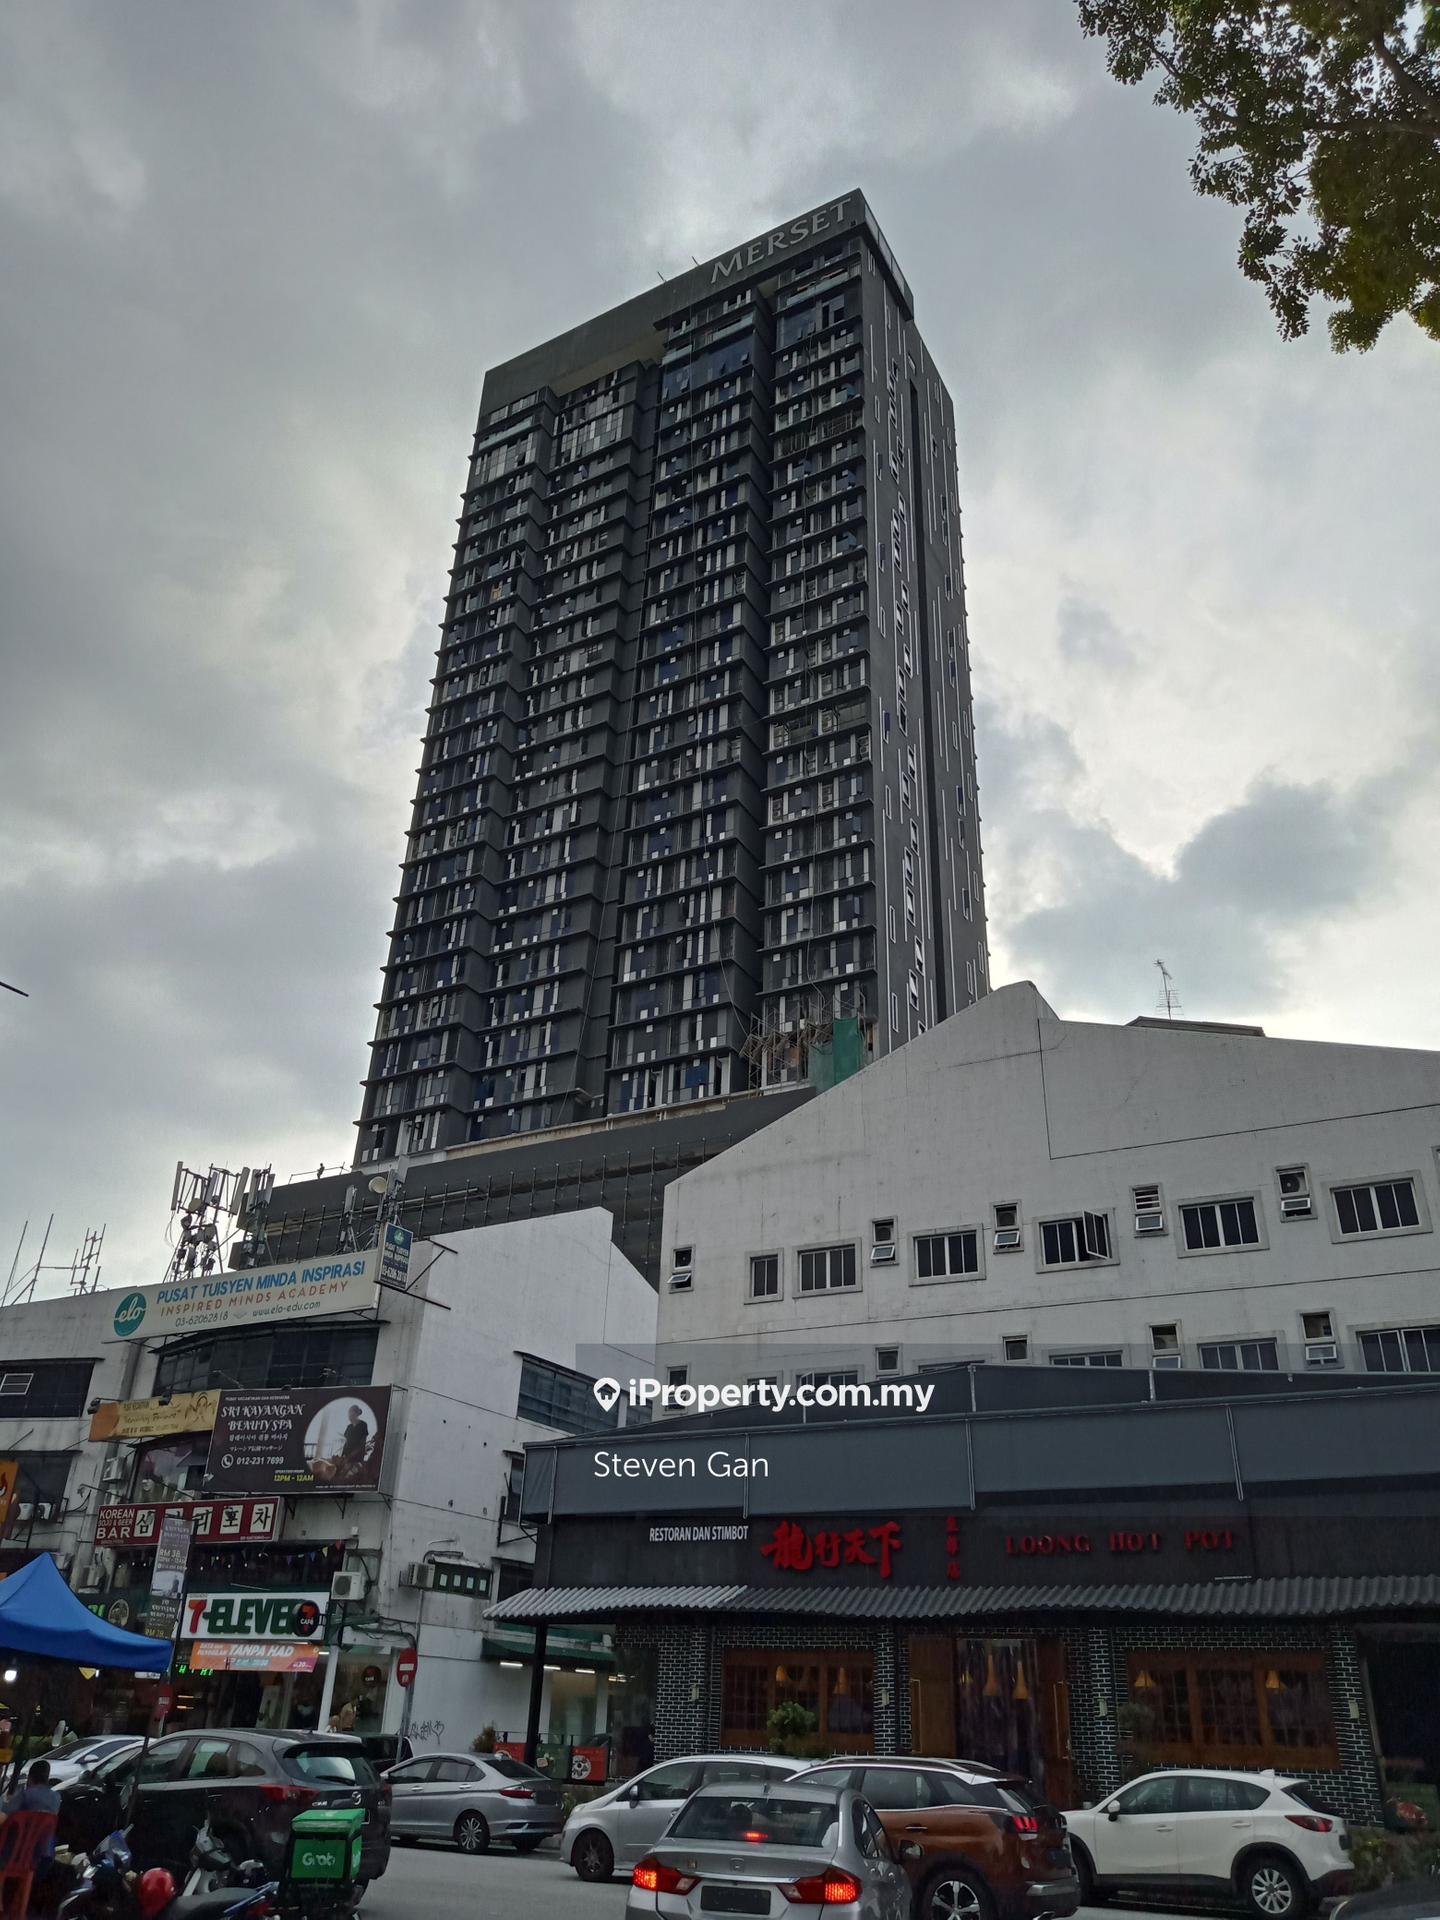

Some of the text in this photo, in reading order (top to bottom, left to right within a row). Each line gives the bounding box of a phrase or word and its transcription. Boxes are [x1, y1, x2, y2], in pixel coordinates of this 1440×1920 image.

[711, 198, 851, 284] MERSET
[157, 1260, 365, 1304] PUSAT TUISYEN MINDA INSPIRASI
[160, 1280, 348, 1317] INSPIRED MINDS ACADEMY
[114, 1295, 146, 1323] elo
[175, 1301, 320, 1328] 03-62062818 www.elo-edu.com
[221, 1403, 306, 1418] SRI KAYANGAN
[228, 1419, 293, 1432] BEAUTY SPA
[236, 1455, 285, 1465] 012-231 7699
[274, 1474, 291, 1482] 12PM
[99, 1509, 135, 1520] KOREAN
[96, 1527, 131, 1539] BAR
[650, 1525, 749, 1543] RESTORAN DAN STIMBOT
[1005, 1530, 1234, 1554] LOONG HOT POT
[229, 1644, 267, 1657] TANPA
[266, 1645, 294, 1657] HAD
[302, 1852, 336, 1866] Grab
